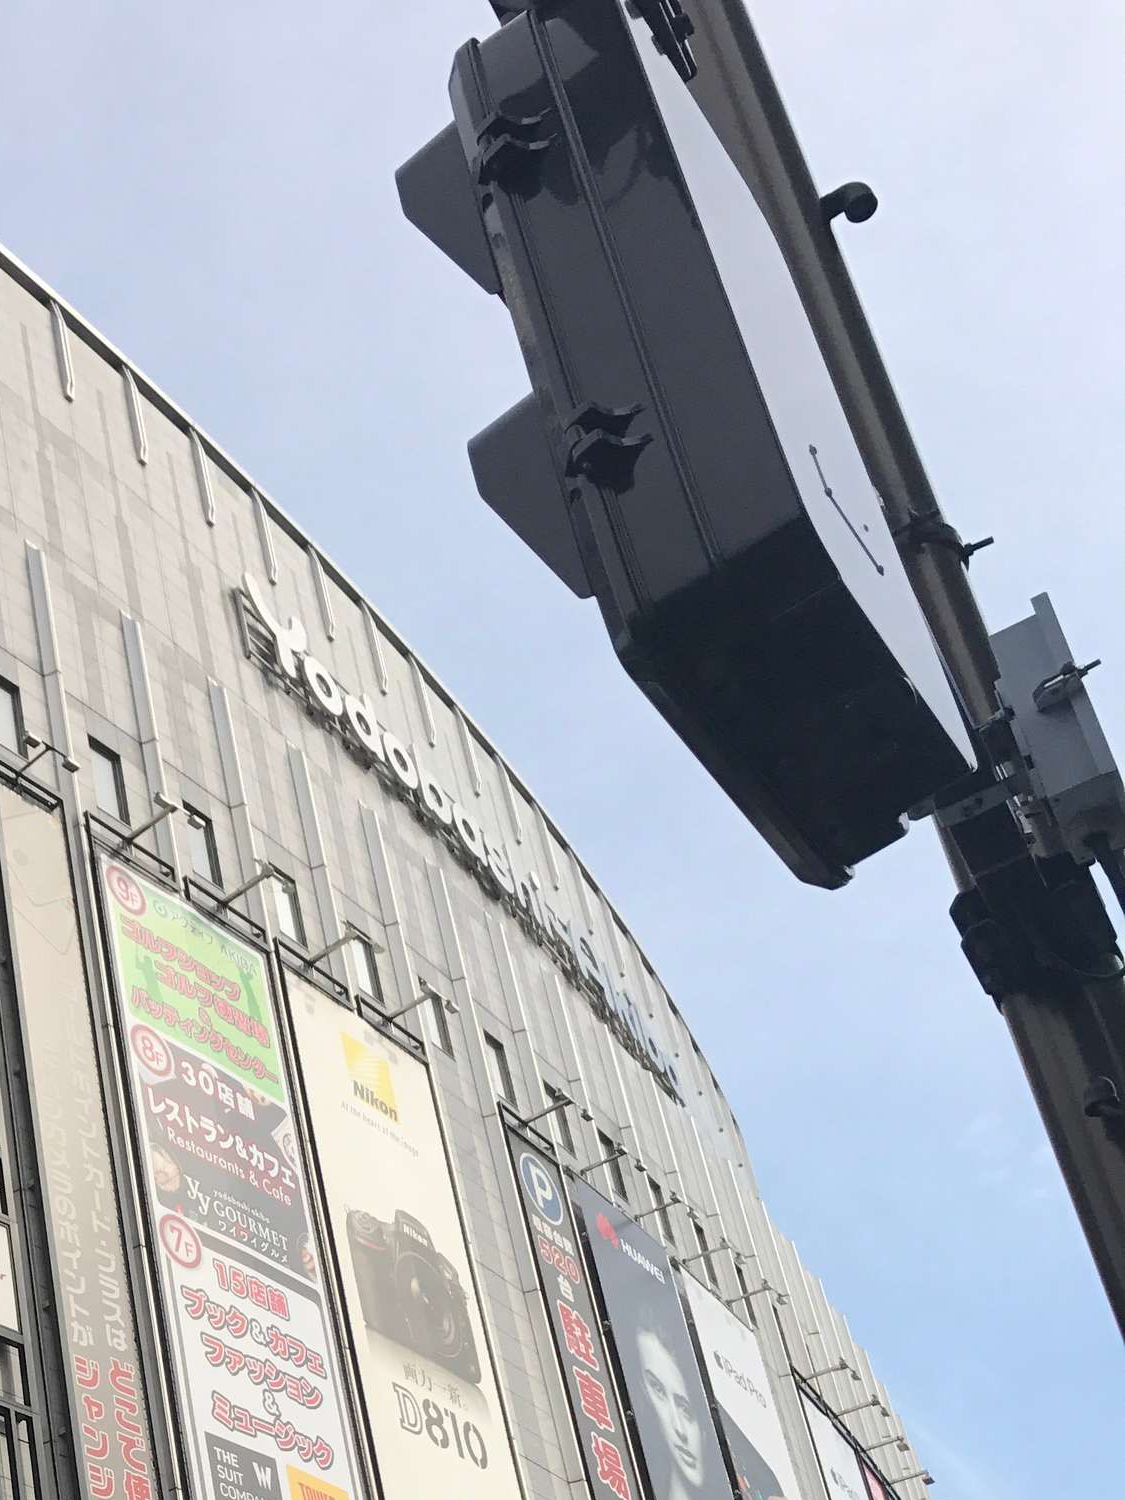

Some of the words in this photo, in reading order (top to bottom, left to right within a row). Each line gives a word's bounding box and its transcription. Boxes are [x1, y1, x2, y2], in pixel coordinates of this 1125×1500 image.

[353, 1079, 398, 1122] Nikon
[168, 1126, 246, 1179] Restaurants
[212, 1201, 289, 1250] GOURMET
[402, 1222, 429, 1247] Nikon
[620, 1238, 665, 1284] HUAWEI
[200, 1332, 323, 1409] ファッション
[211, 1390, 334, 1470] ミュージック
[392, 1382, 488, 1470] D810
[213, 1446, 239, 1468] THE
[217, 1464, 244, 1487] SUIT
